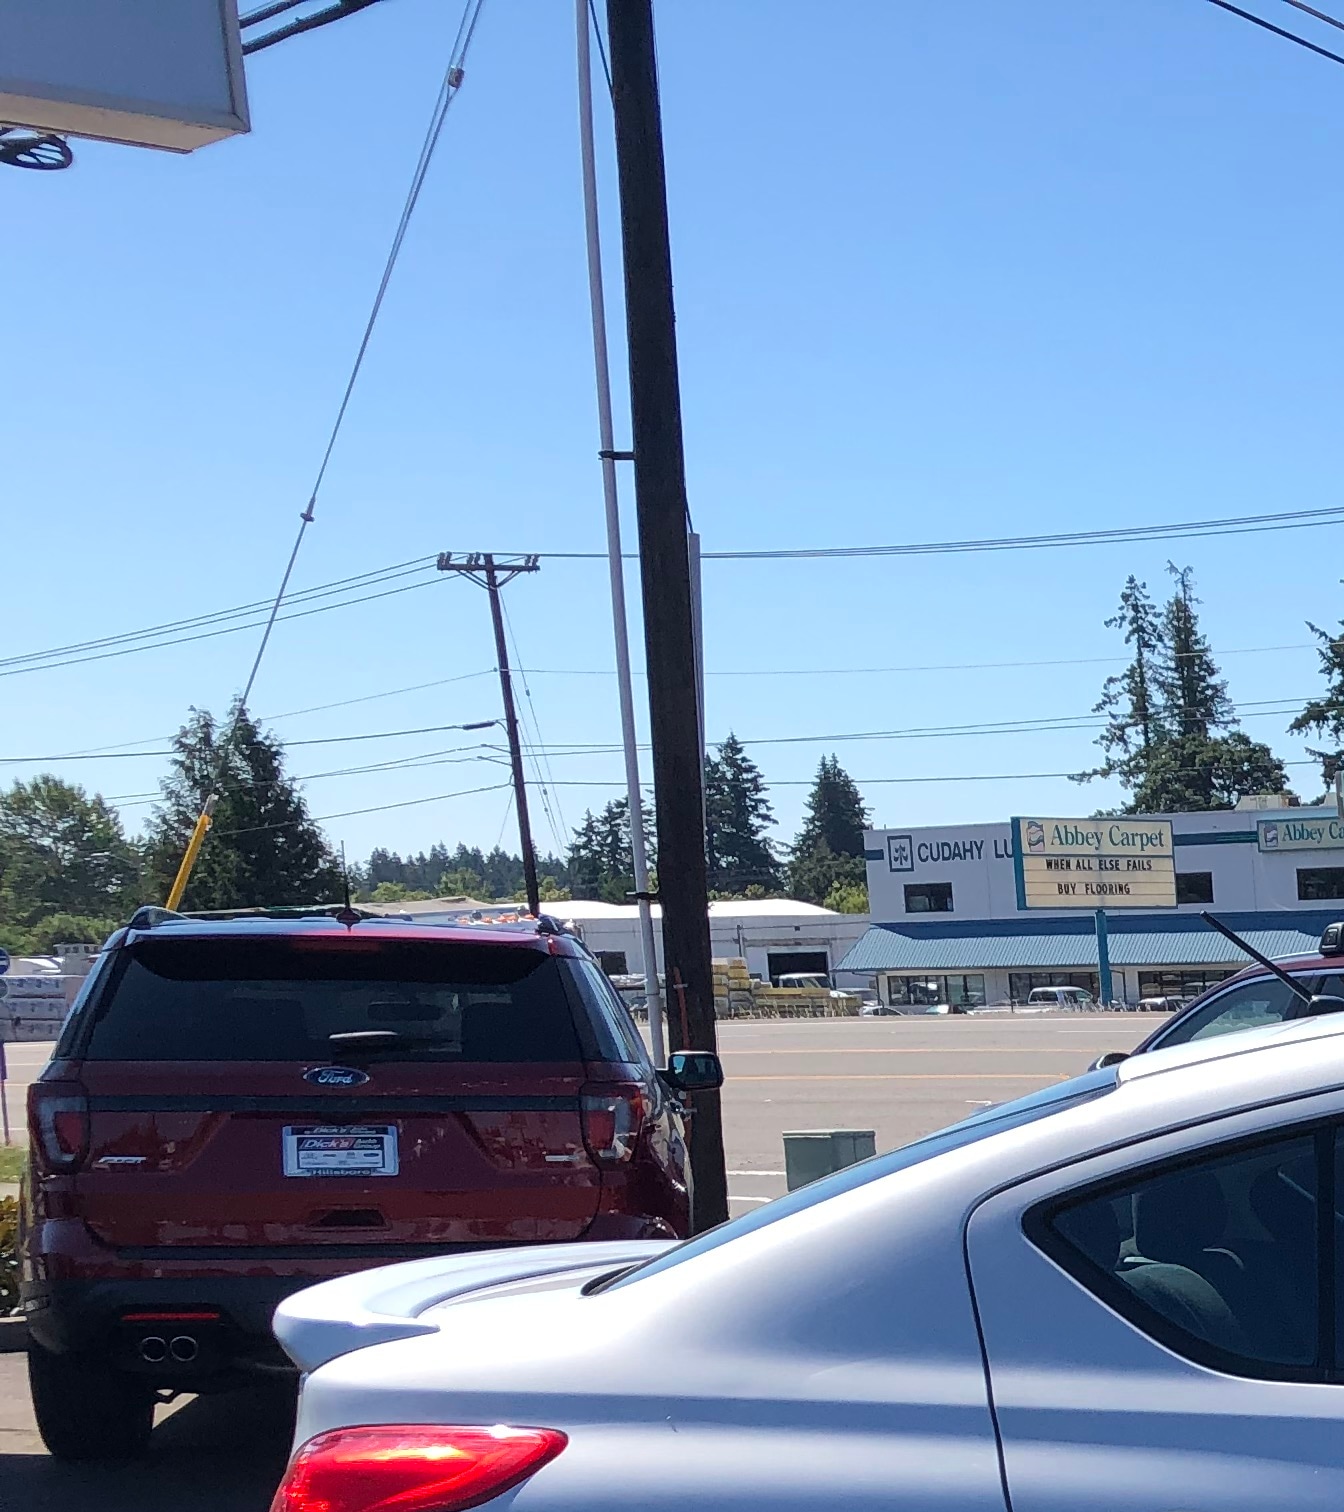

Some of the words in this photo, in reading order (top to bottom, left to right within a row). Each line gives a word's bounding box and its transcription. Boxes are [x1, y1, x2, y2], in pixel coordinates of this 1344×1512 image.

[1050, 824, 1103, 851] Abbey
[1108, 825, 1165, 852] Carpet
[1281, 824, 1325, 844] Abbey
[917, 839, 985, 863] CUDAHY
[1045, 858, 1071, 871] WHEN
[1075, 859, 1094, 871] ALL
[1098, 859, 1121, 871] ELSE
[1126, 859, 1153, 872] FAILS
[1057, 883, 1077, 896] BUY
[1085, 883, 1131, 896] FLOORING
[317, 1069, 353, 1084] Ford
[304, 1139, 350, 1149] Dick's
